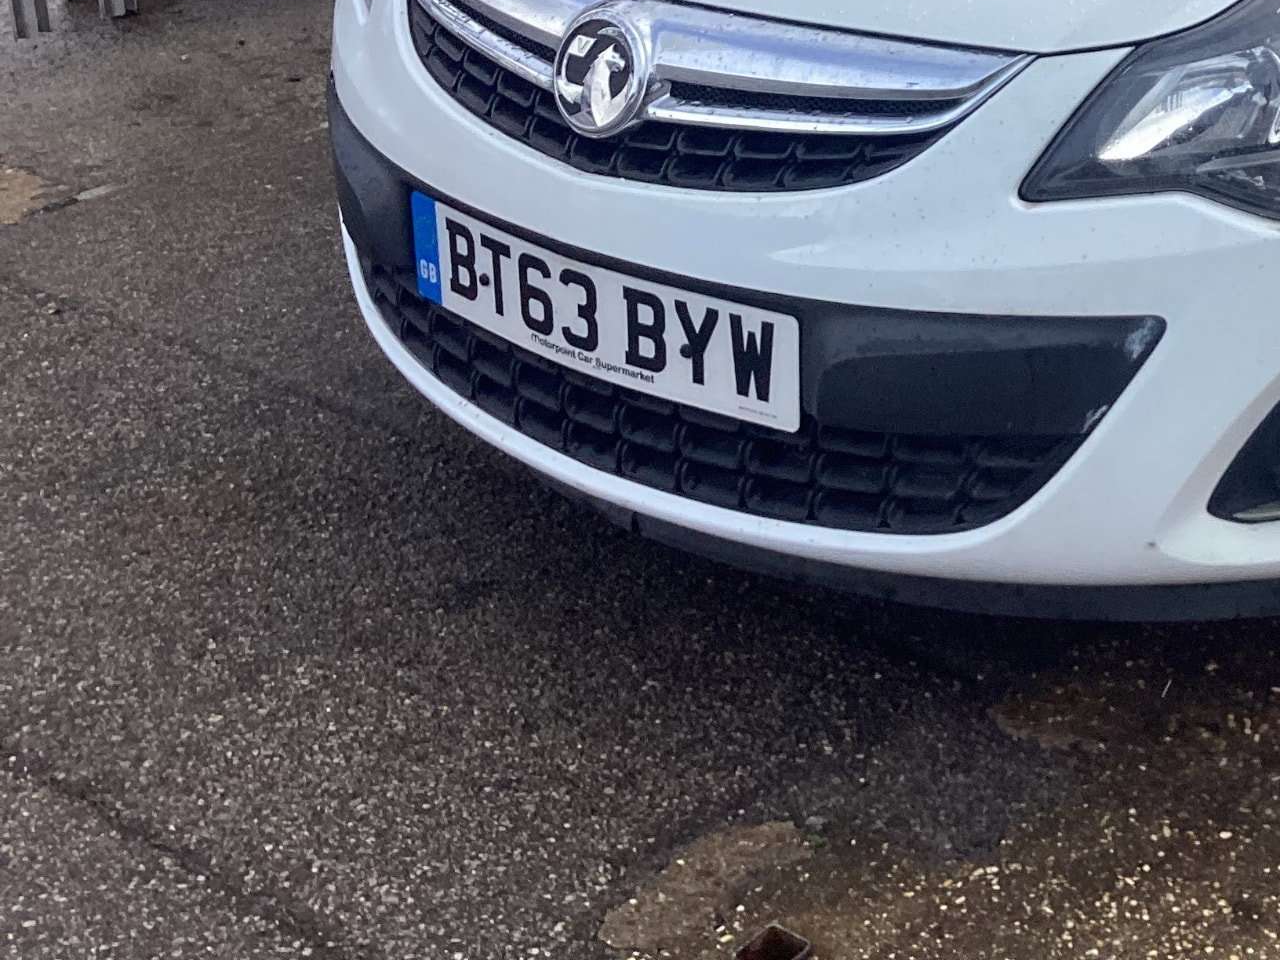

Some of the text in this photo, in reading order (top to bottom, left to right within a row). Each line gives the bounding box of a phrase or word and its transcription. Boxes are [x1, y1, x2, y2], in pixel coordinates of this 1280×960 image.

[420, 258, 437, 283] GB
[445, 217, 775, 403] BT63 BYW
[577, 351, 592, 363] Car
[594, 358, 655, 384] Supermarket
